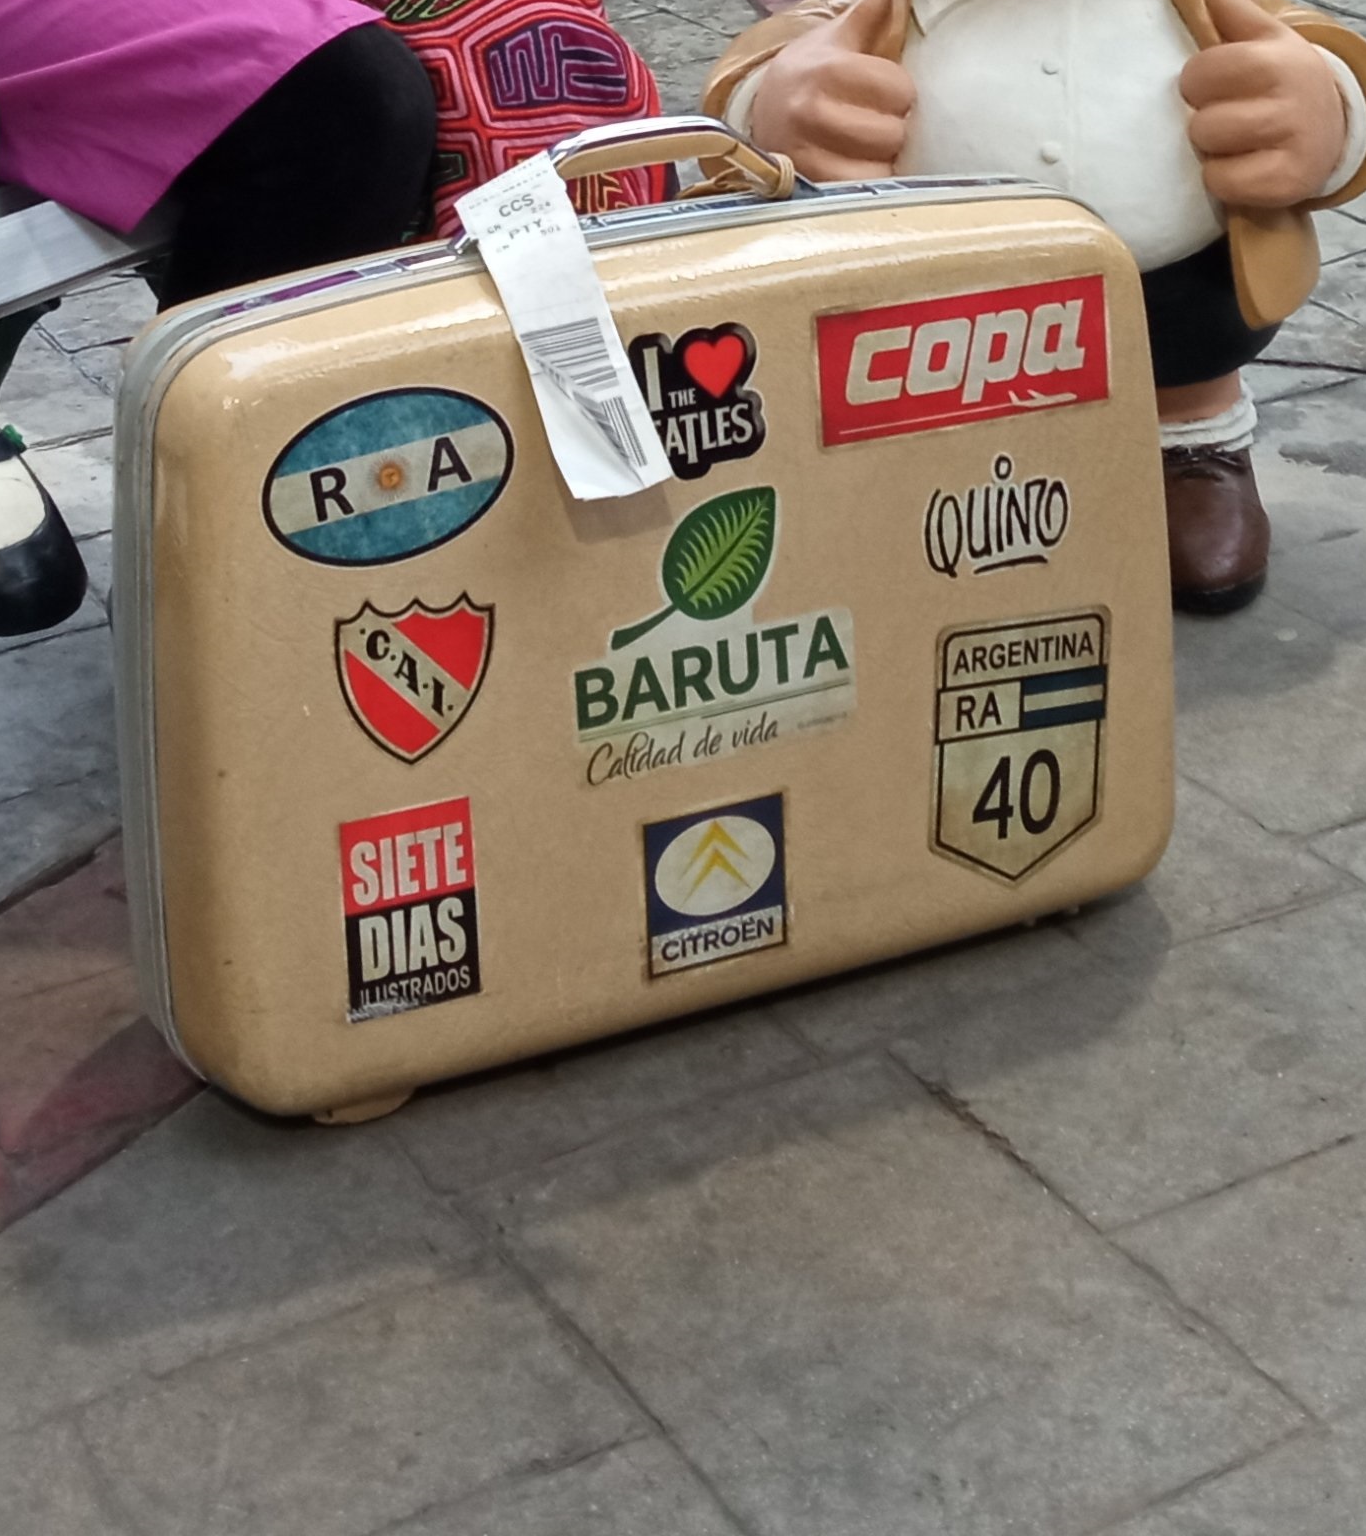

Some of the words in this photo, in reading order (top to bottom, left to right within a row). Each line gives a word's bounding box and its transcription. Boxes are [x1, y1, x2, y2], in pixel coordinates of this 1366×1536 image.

[498, 193, 534, 217] CCS
[509, 218, 542, 240] PTY
[668, 388, 697, 409] THE
[656, 403, 754, 465] ATLES
[309, 467, 355, 523] R
[427, 436, 473, 492] A
[574, 615, 850, 731] BARUTA
[953, 631, 1095, 676] ARGENTINA
[955, 690, 1003, 732] RA
[586, 731, 686, 787] Calidad
[693, 724, 723, 758] de
[732, 711, 779, 748] vida
[971, 749, 1061, 840] 40
[349, 821, 468, 906] SIETE
[358, 897, 467, 983] DIAS
[360, 965, 472, 1007] ILUSTRADOS
